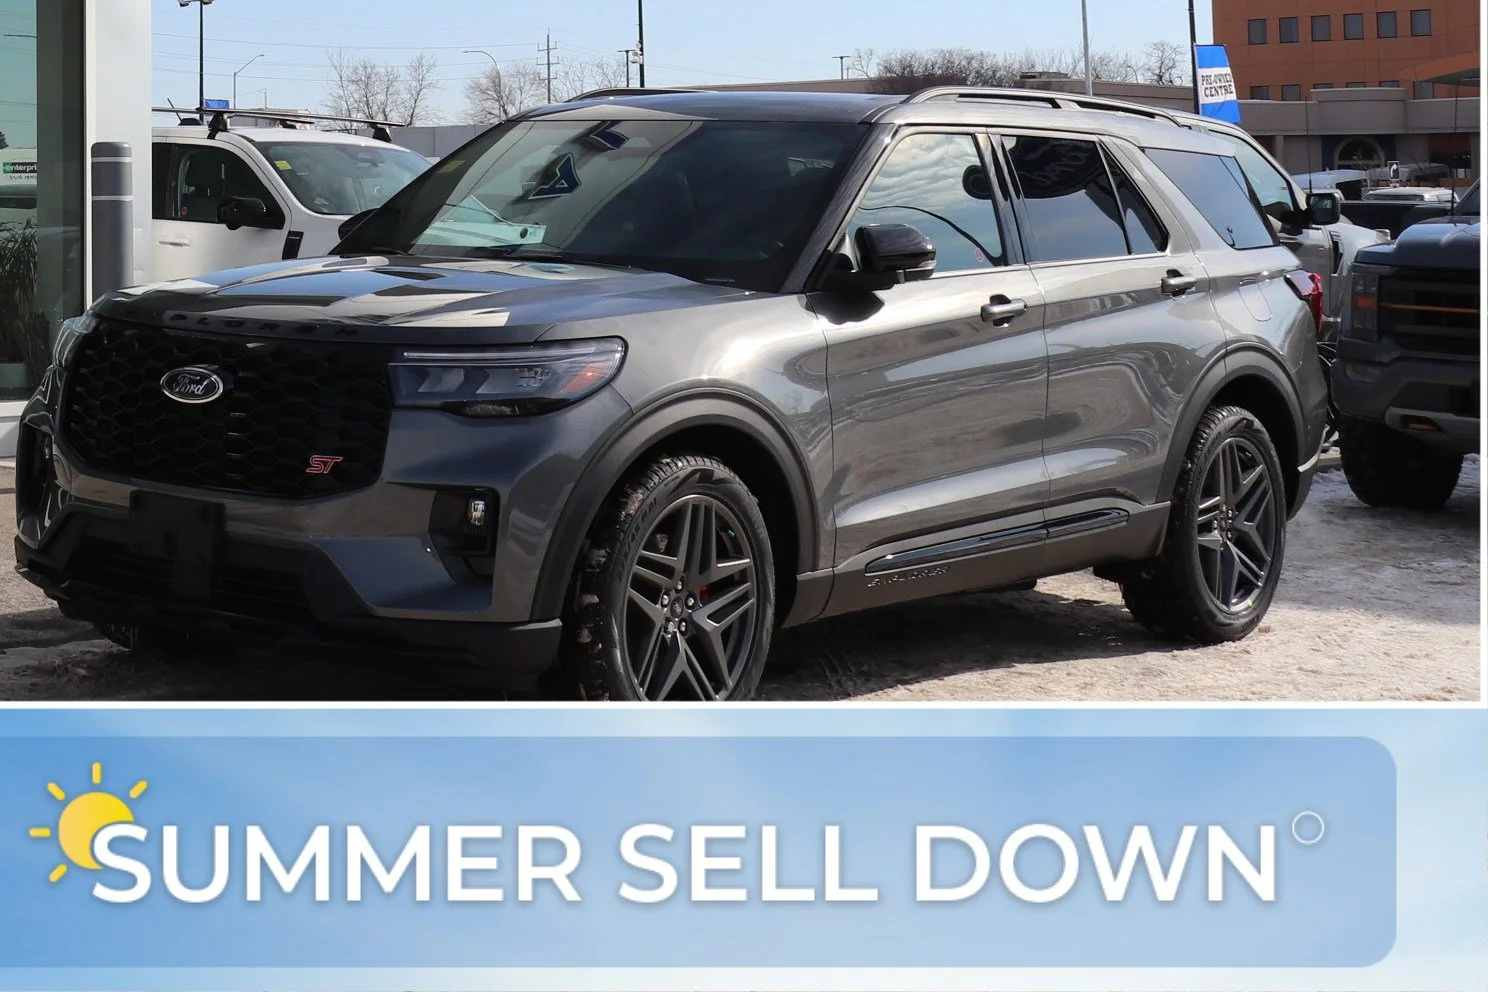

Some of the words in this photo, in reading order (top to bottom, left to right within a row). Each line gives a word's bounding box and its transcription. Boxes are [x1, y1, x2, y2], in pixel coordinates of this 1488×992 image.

[1204, 84, 1233, 97] CENTRE
[172, 372, 211, 396] Ford
[305, 454, 344, 475] ST
